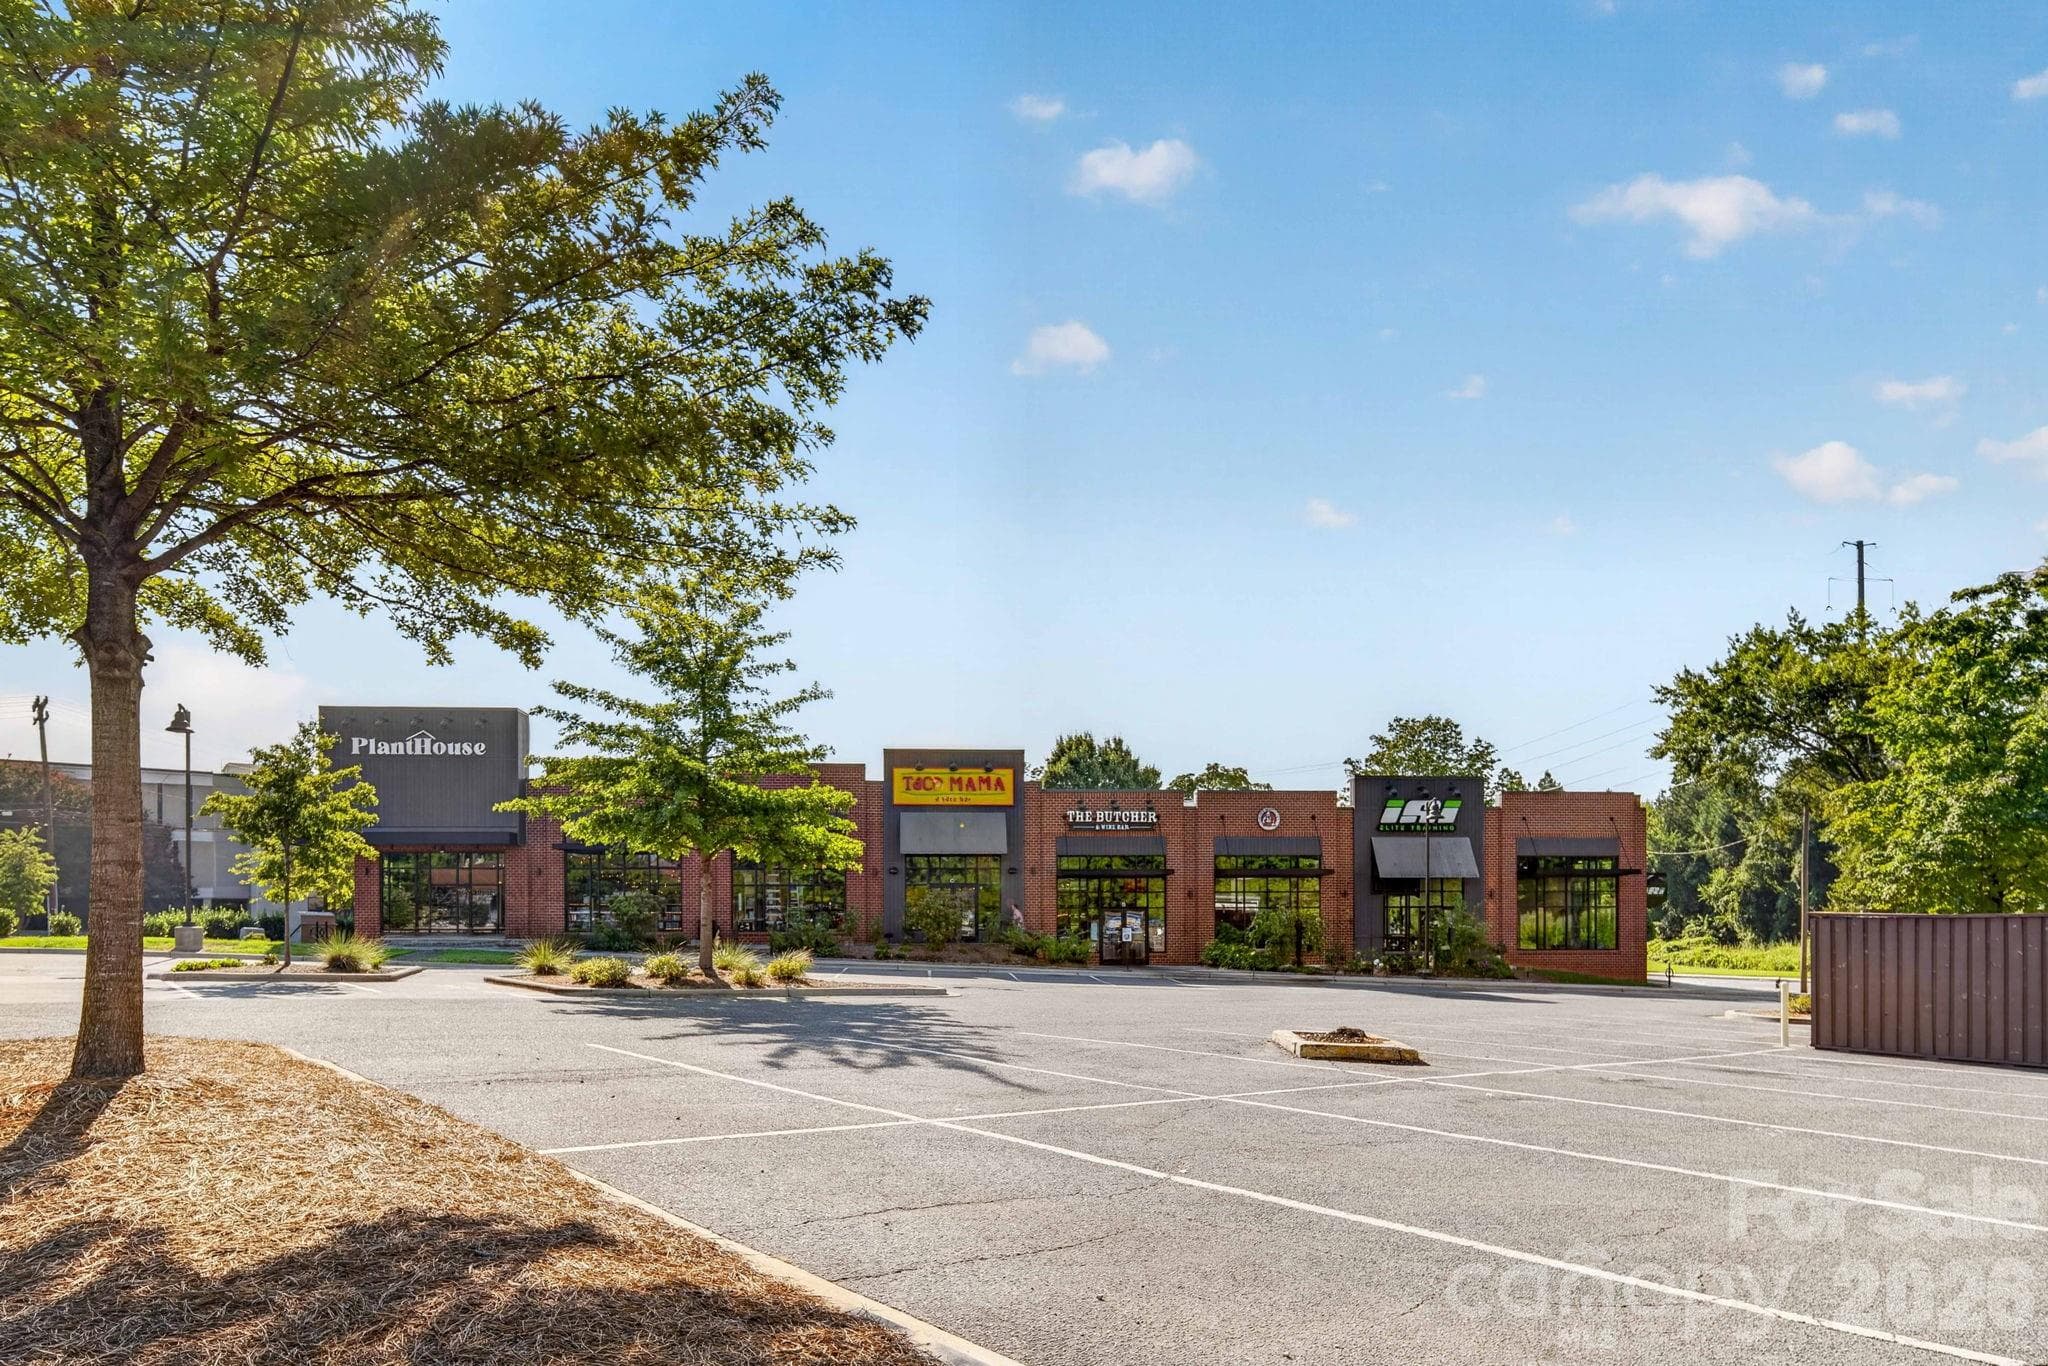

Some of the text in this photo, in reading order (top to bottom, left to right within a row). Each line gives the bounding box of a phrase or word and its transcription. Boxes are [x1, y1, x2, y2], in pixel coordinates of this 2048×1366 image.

[351, 736, 487, 756] PlantHouse
[948, 775, 1004, 791] MAMA
[1067, 811, 1157, 822] THE BUTCHER
[1411, 824, 1456, 832] TRAINING
